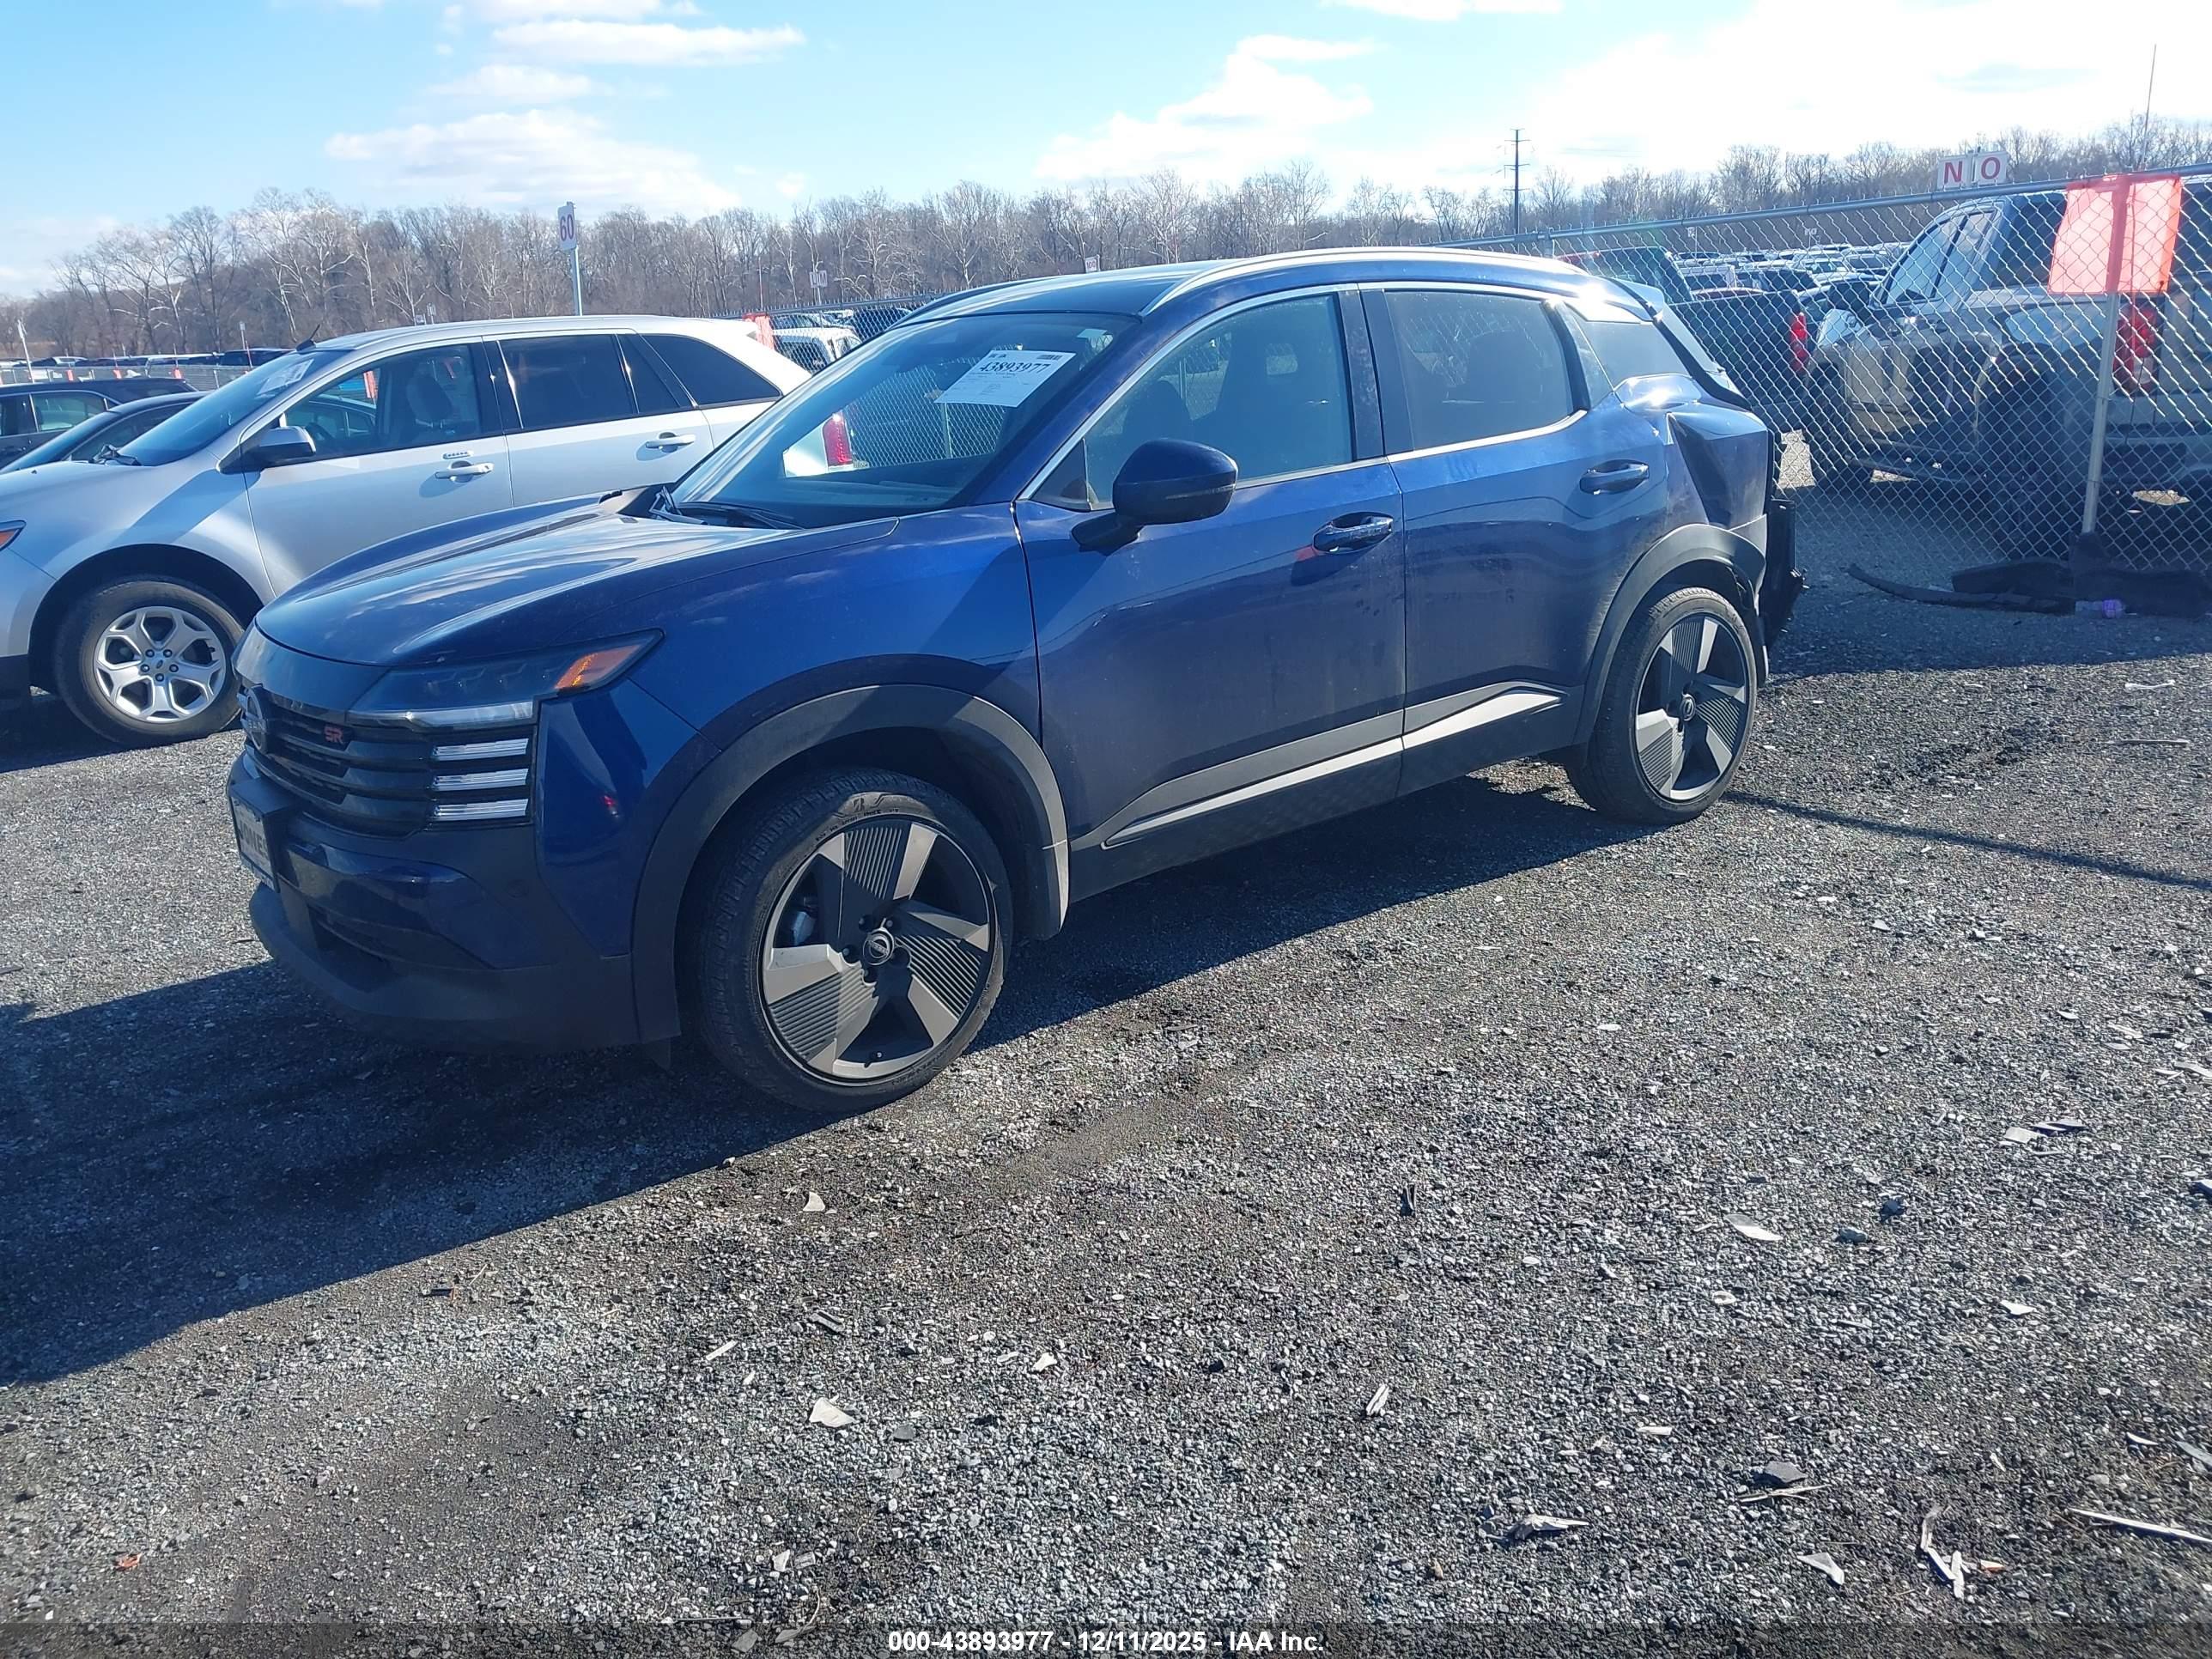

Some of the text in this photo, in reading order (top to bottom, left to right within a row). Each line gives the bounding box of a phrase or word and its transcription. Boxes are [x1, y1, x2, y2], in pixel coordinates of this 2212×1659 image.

[1943, 156, 2001, 184] N O
[560, 214, 574, 241] 60
[980, 362, 1051, 374] 43893977
[324, 726, 343, 744] SR
